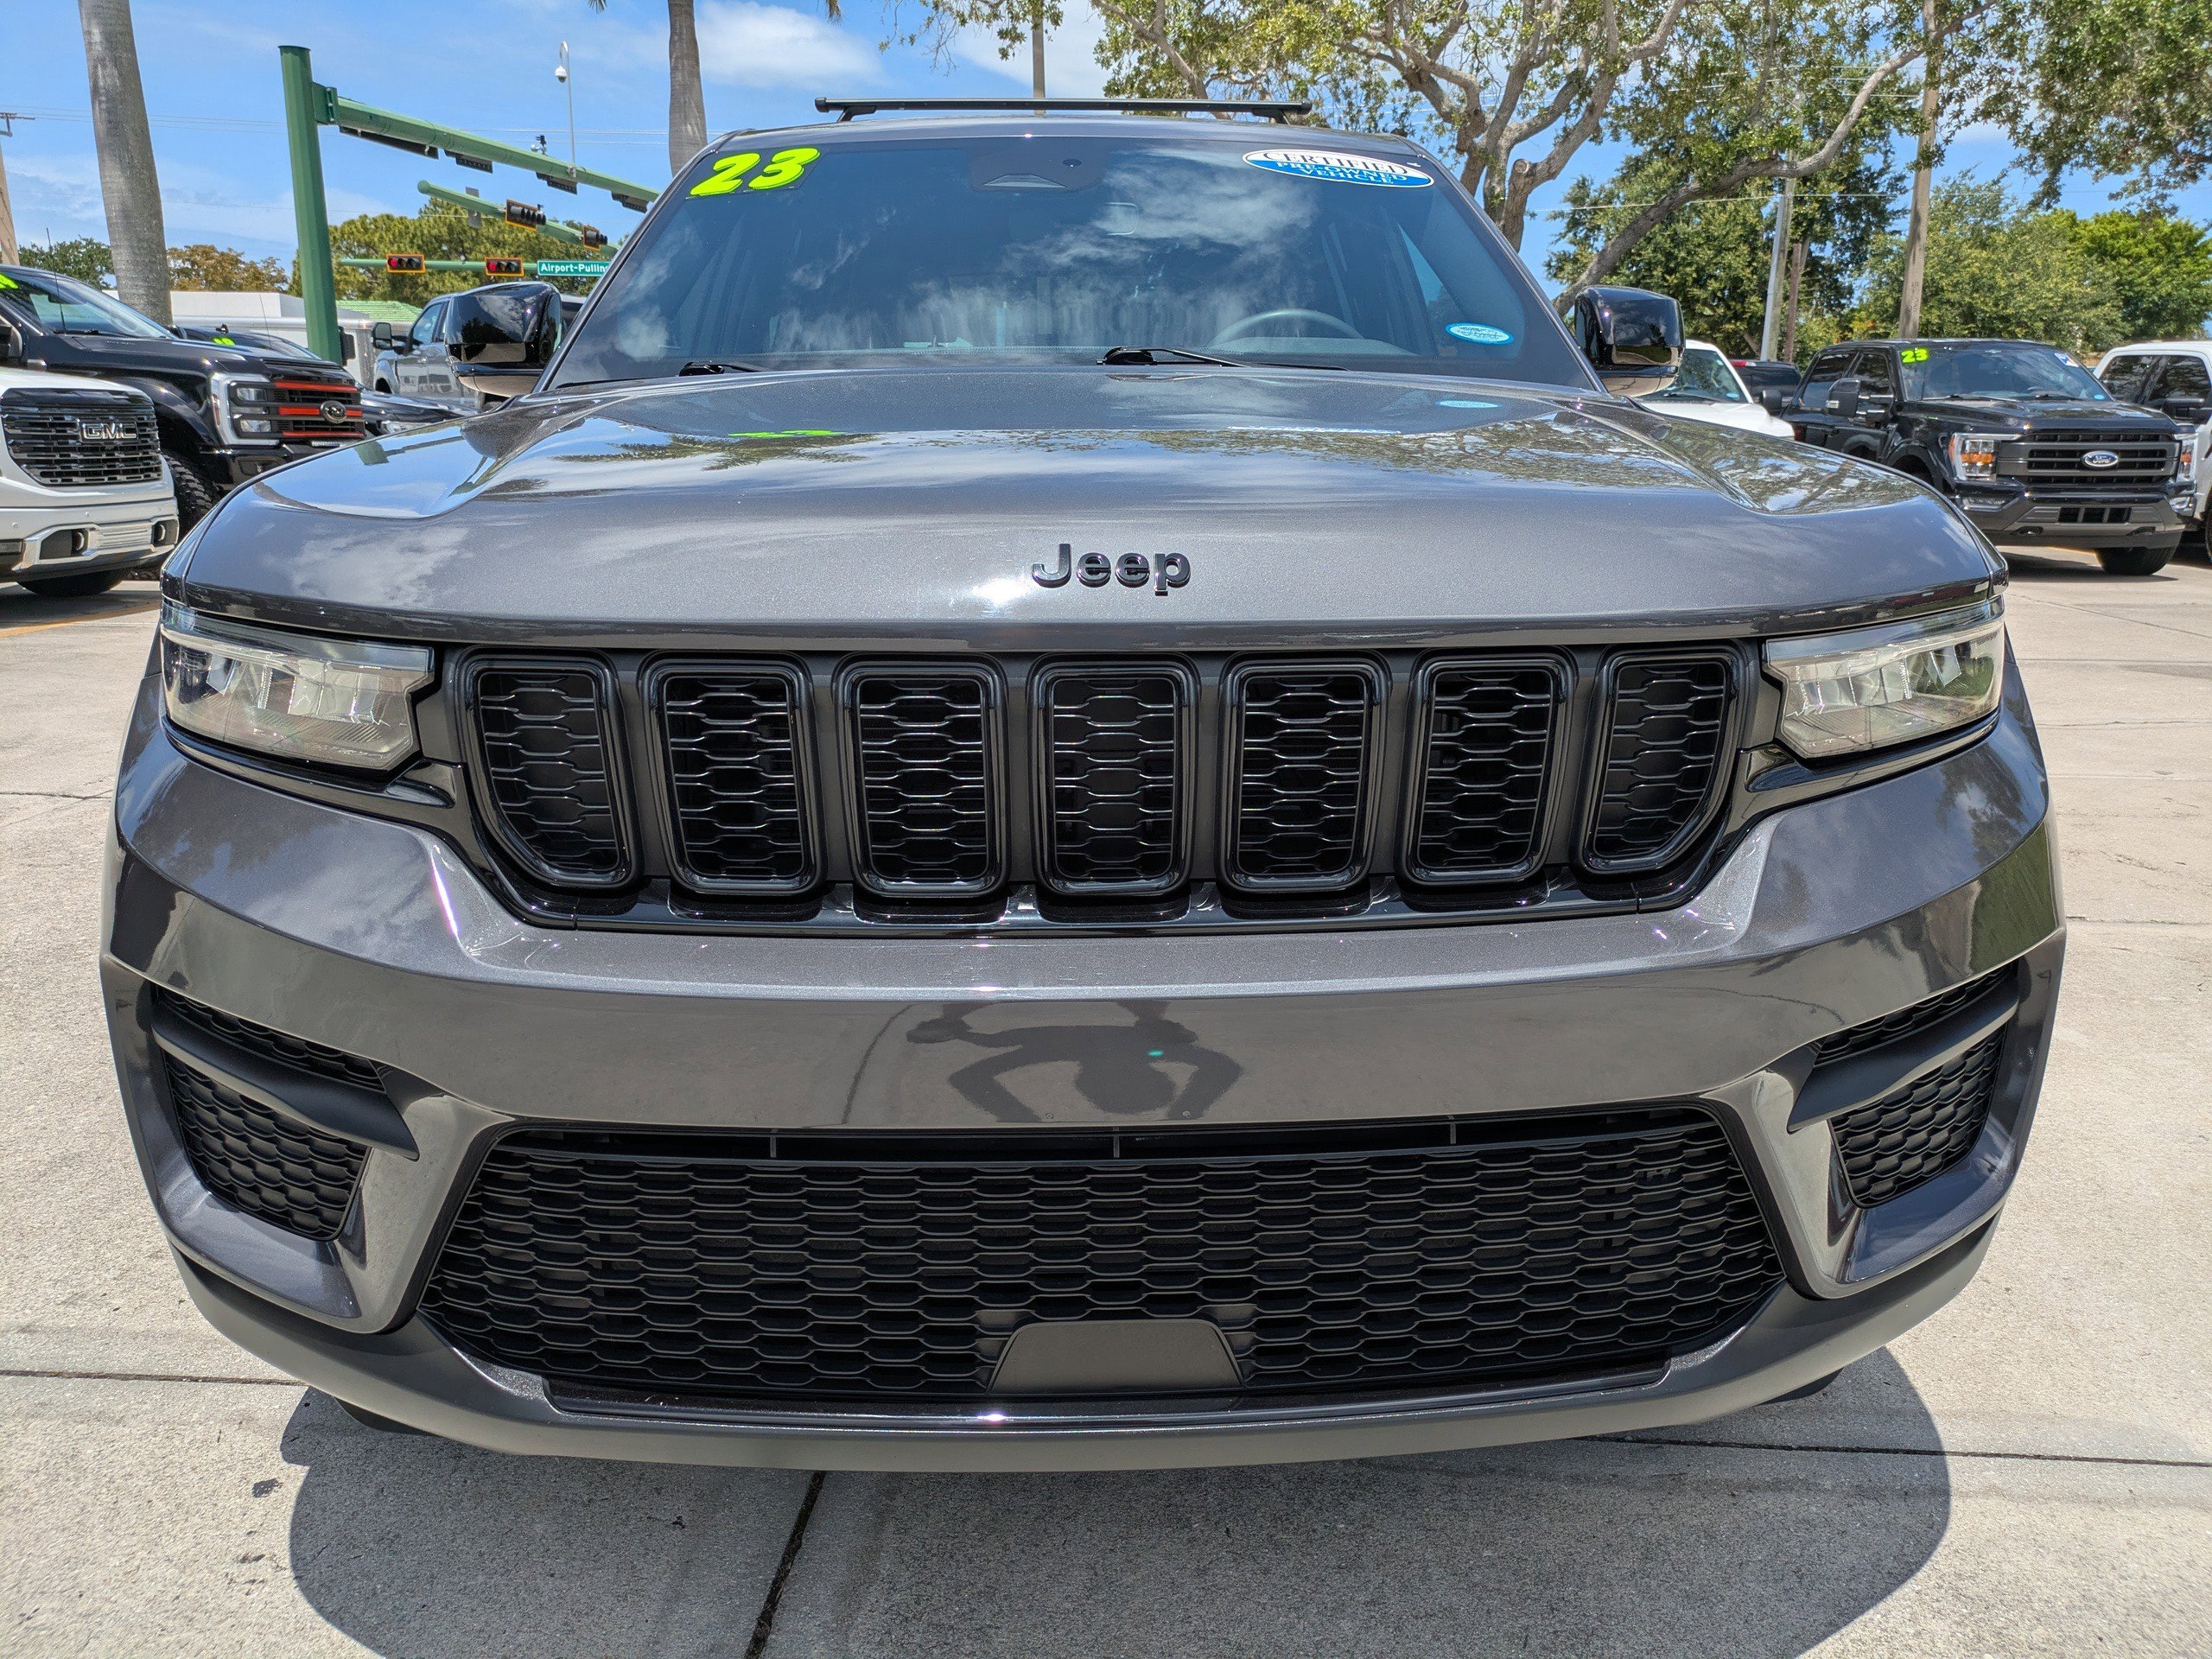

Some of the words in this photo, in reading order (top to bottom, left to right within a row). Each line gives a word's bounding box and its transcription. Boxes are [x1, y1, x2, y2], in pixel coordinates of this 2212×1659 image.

[690, 148, 821, 196] 23
[1262, 152, 1408, 175] CERTIFIED
[1275, 162, 1408, 181] PRE-OWNED
[1299, 168, 1395, 185] VEHICLE
[540, 263, 608, 274] Airport-Pullin
[1901, 348, 1928, 363] 23
[82, 423, 137, 440] GMC
[1031, 543, 1191, 596] Jeep
